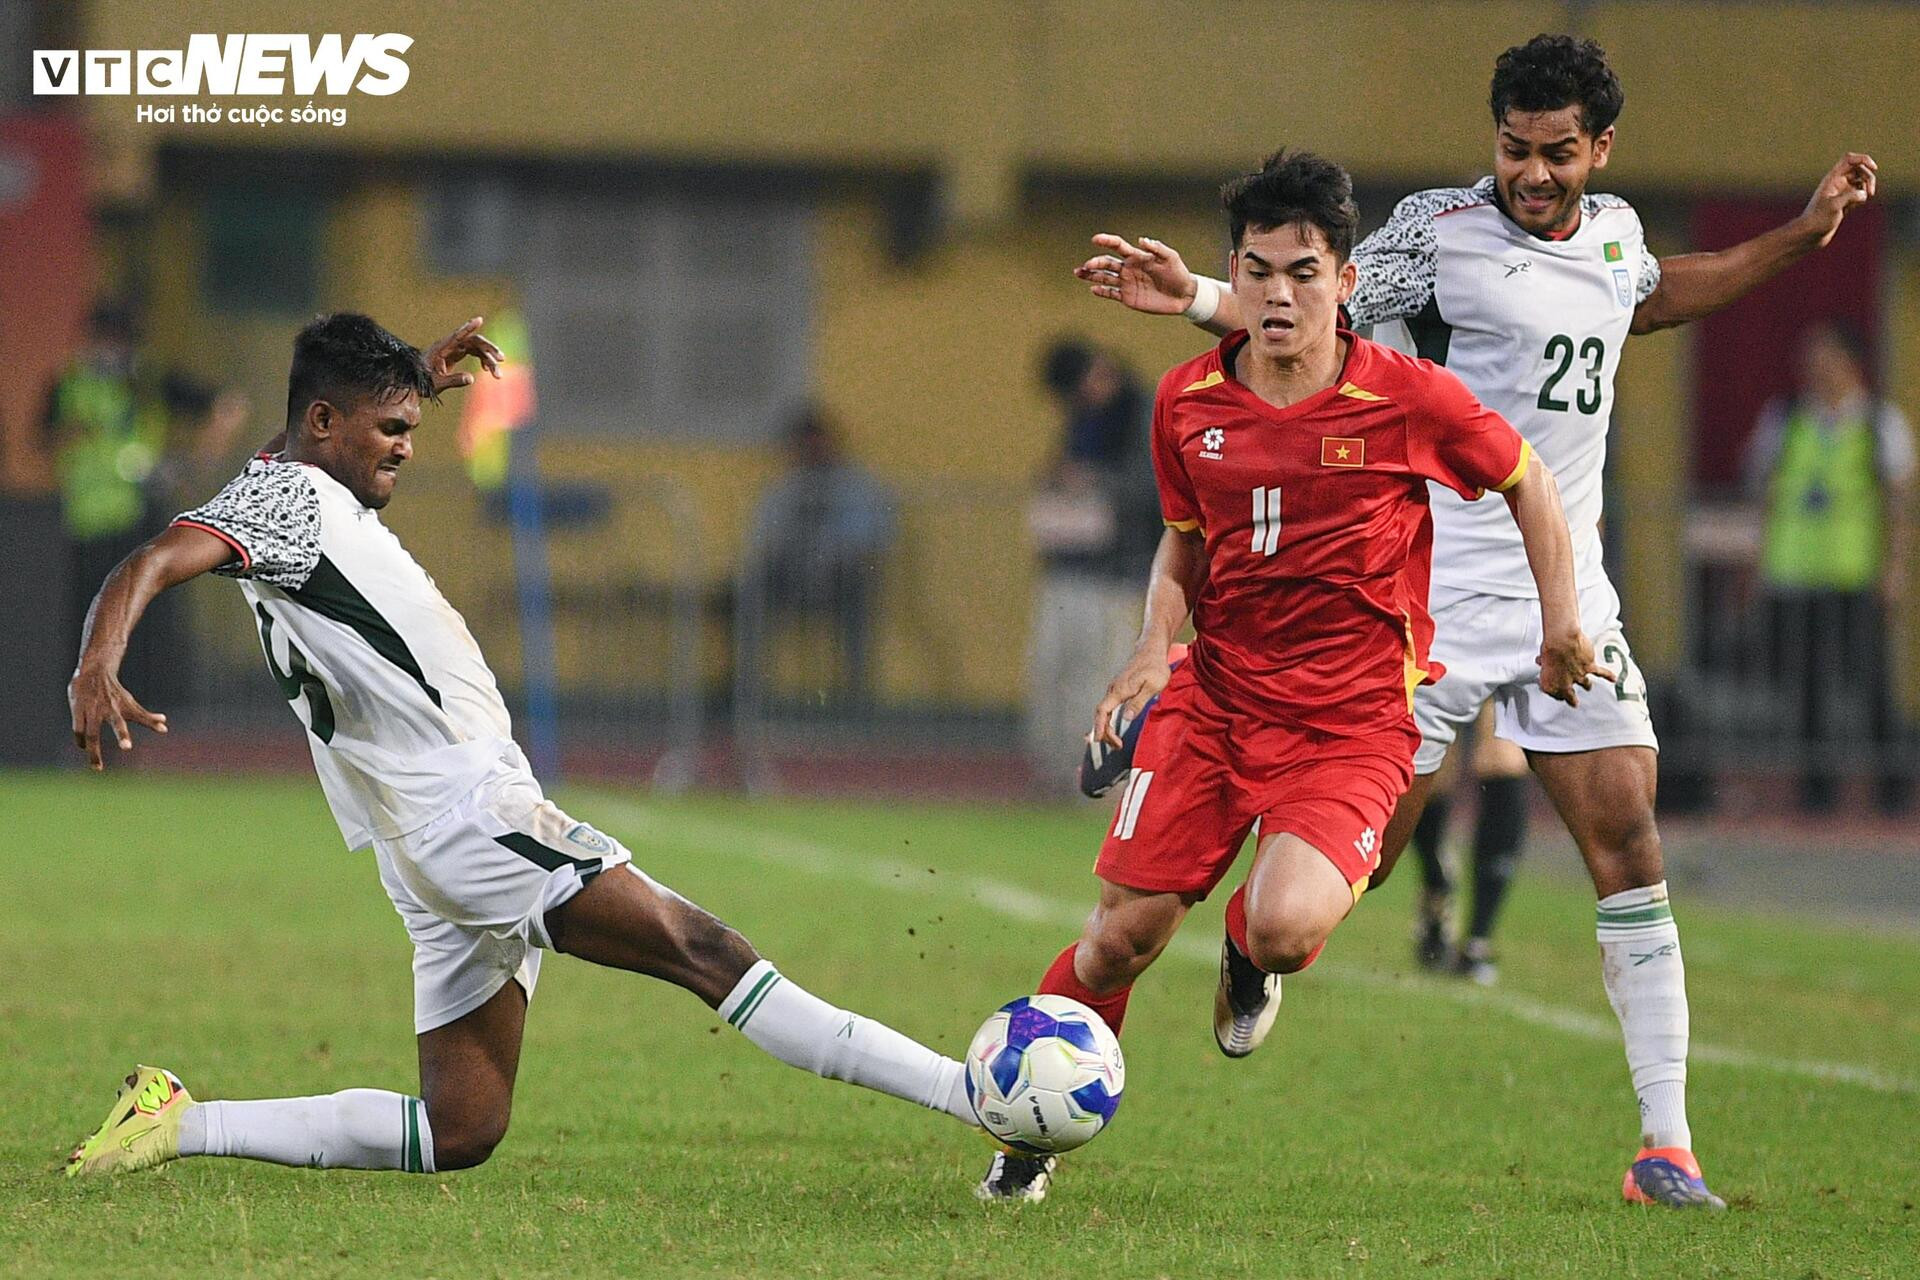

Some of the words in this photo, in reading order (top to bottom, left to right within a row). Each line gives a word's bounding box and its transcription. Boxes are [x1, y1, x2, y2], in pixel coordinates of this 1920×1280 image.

[1537, 333, 1605, 416] 23
[1251, 485, 1282, 557] 11
[1112, 767, 1155, 841] 11
